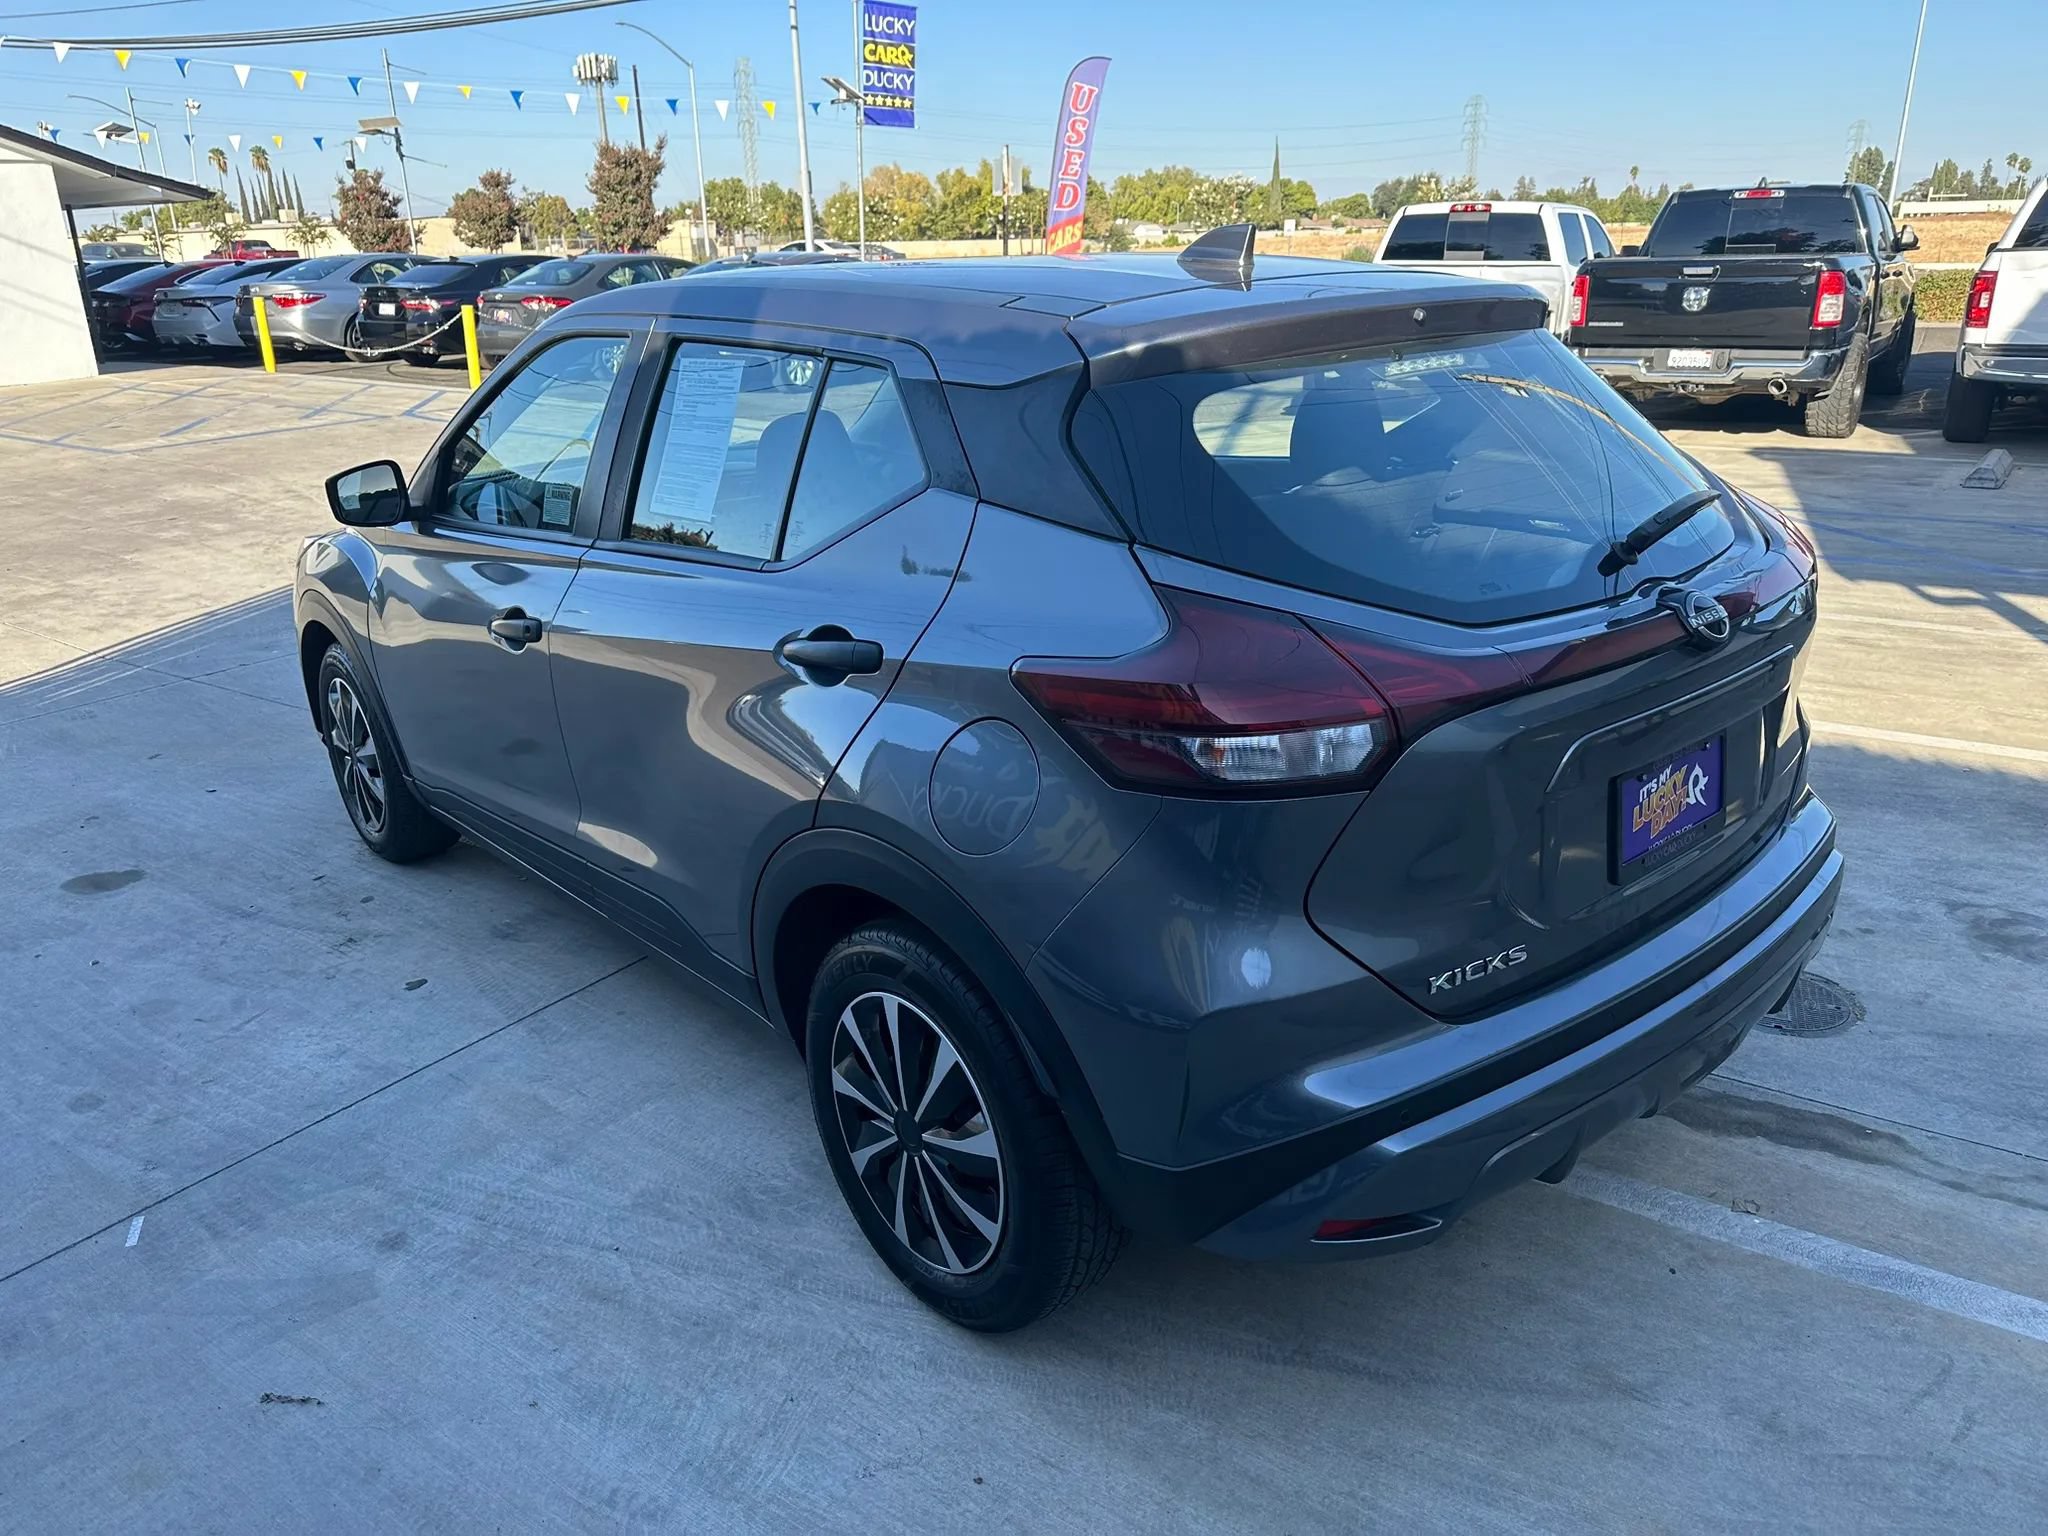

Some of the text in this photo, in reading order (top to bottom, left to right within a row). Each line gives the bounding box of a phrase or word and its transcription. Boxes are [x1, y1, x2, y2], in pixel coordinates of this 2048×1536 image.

[864, 13, 915, 36] LUCKY
[863, 69, 914, 91] DUCKY
[1054, 82, 1098, 211] USED
[1047, 221, 1083, 255] CARS
[1691, 606, 1726, 627] NISS
[1633, 764, 1688, 832] LUCKY
[1640, 764, 1672, 803] IT'S MY
[1428, 944, 1527, 995] KICKS
